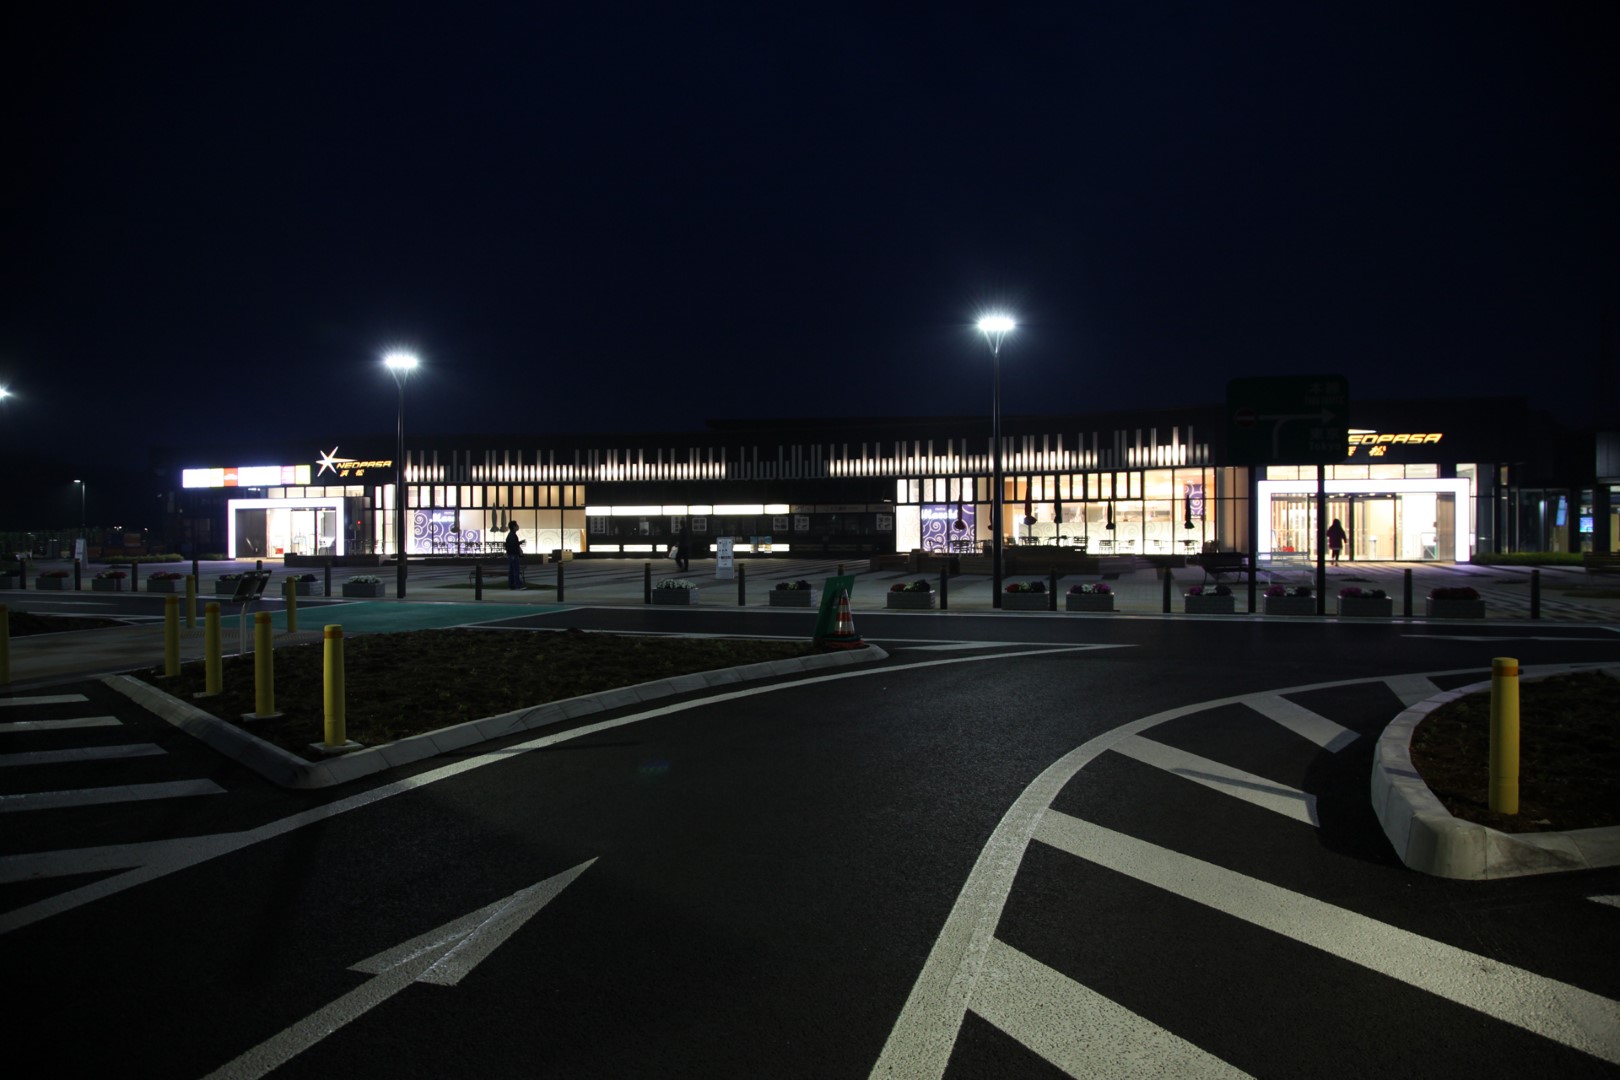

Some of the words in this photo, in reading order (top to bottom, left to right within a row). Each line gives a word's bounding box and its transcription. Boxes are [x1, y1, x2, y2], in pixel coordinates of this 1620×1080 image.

[1348, 433, 1443, 444] EOPASA
[1308, 441, 1342, 453] Tokyo
[336, 461, 392, 469] NEOPASA
